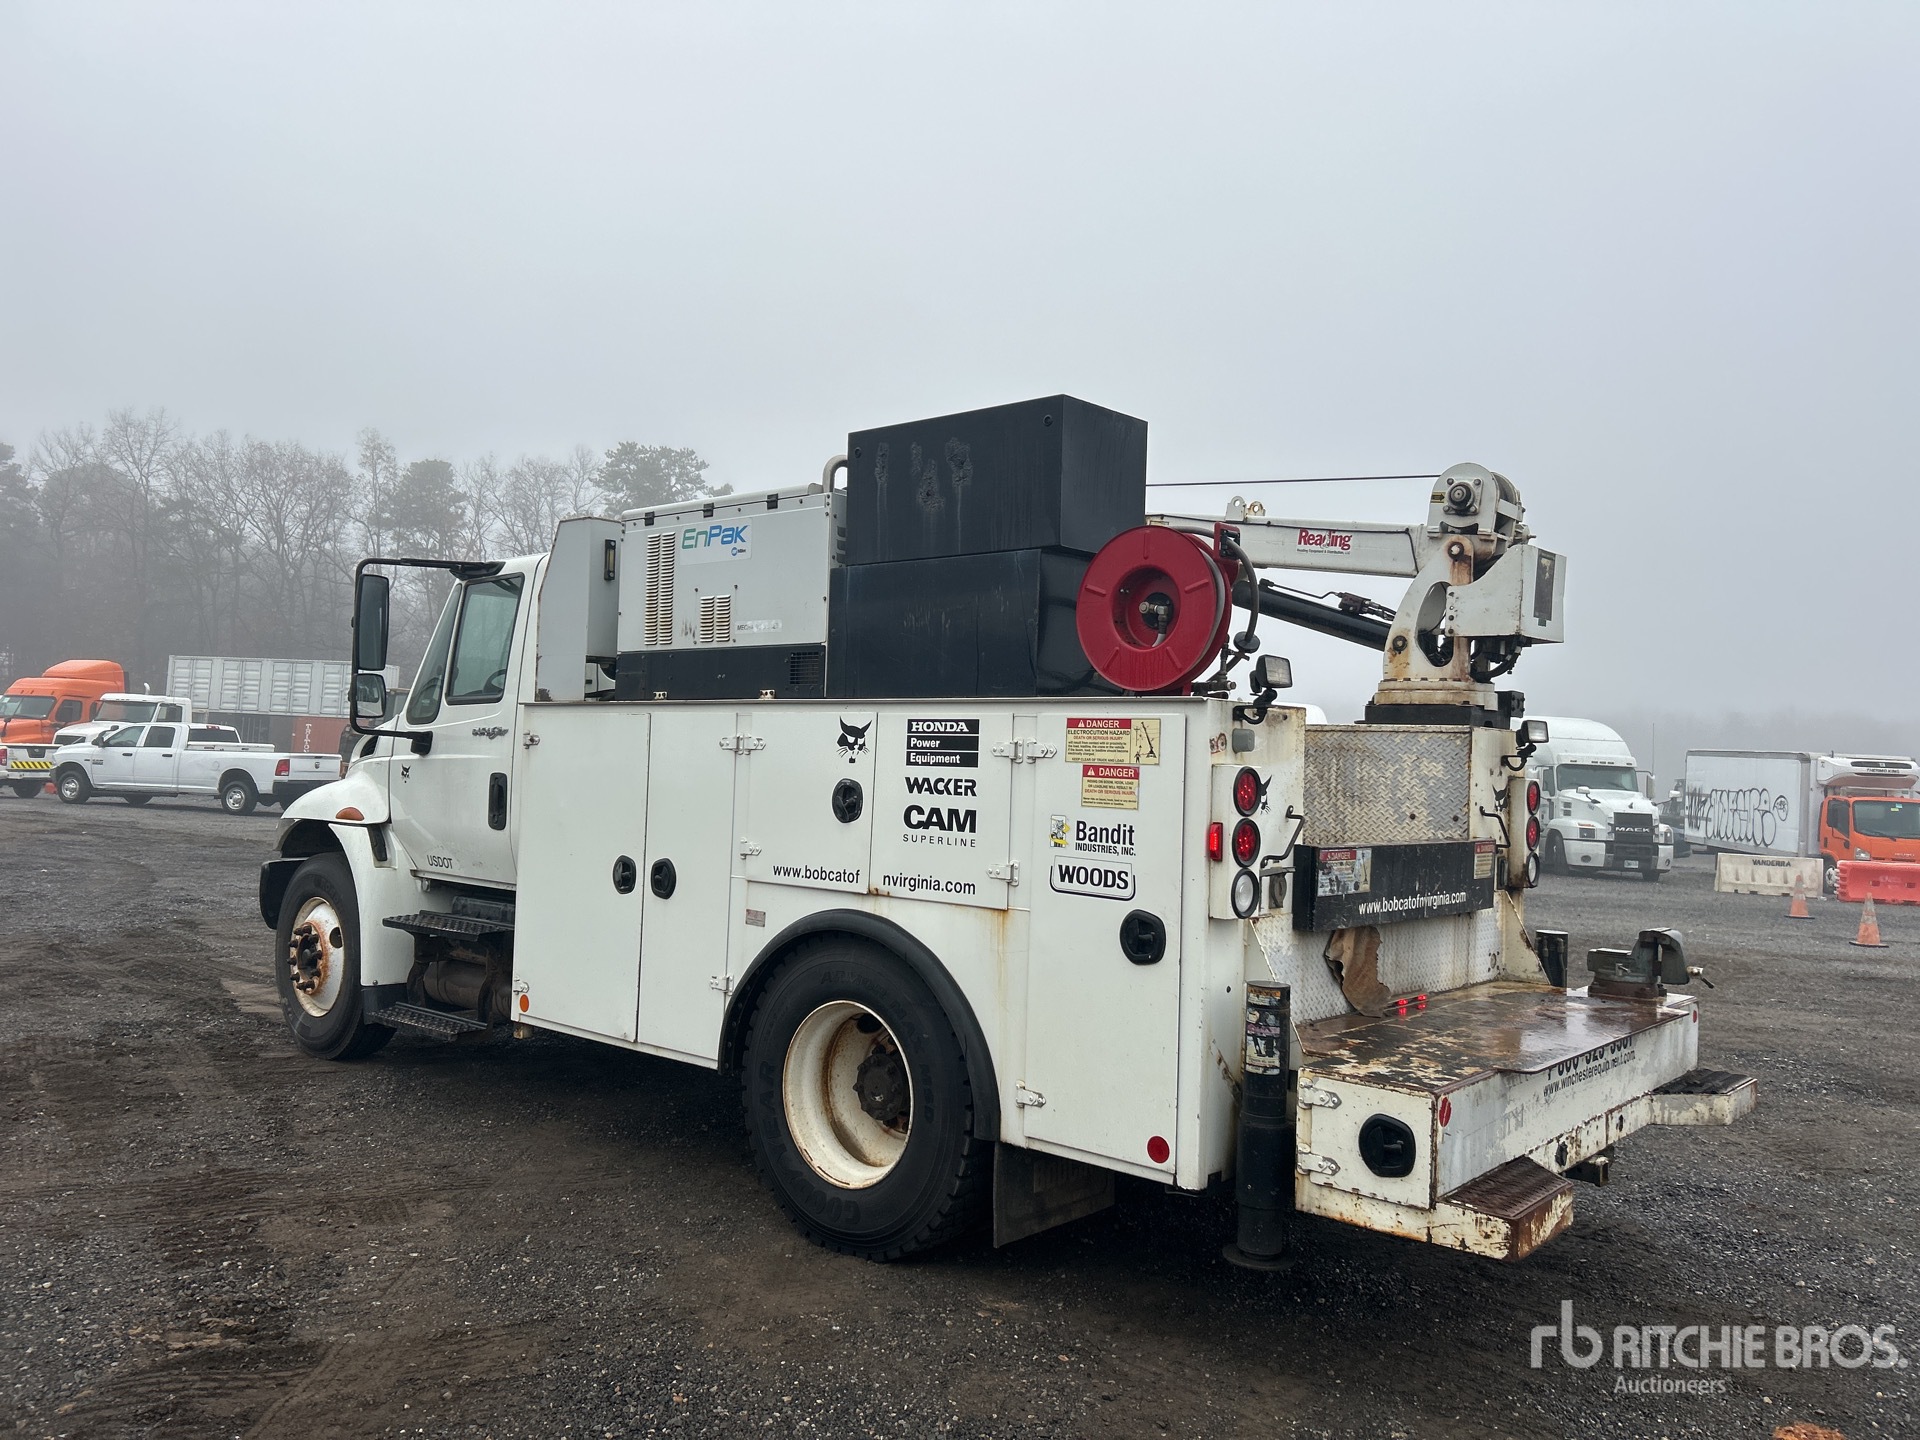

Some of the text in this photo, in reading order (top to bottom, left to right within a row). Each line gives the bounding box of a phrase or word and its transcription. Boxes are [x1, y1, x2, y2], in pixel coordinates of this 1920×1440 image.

[682, 525, 749, 549] EnPak
[1298, 529, 1352, 550] Reading
[911, 721, 969, 732] HONDA
[1086, 720, 1119, 728] DANGER
[910, 738, 940, 747] Power
[910, 753, 960, 764] Equipment
[1099, 768, 1134, 777] DANGER
[905, 777, 977, 797] WACKER
[904, 805, 977, 833] CAM
[1076, 820, 1134, 845] Bandit
[903, 834, 976, 847] SUPERLINE
[1075, 843, 1136, 856] INDUSTRIES, INC.
[427, 855, 453, 869] USDOT
[1752, 859, 1791, 867] VANDERRA
[773, 865, 976, 895] www.bobcatof nvirginia.com
[1058, 864, 1129, 890] WOODS
